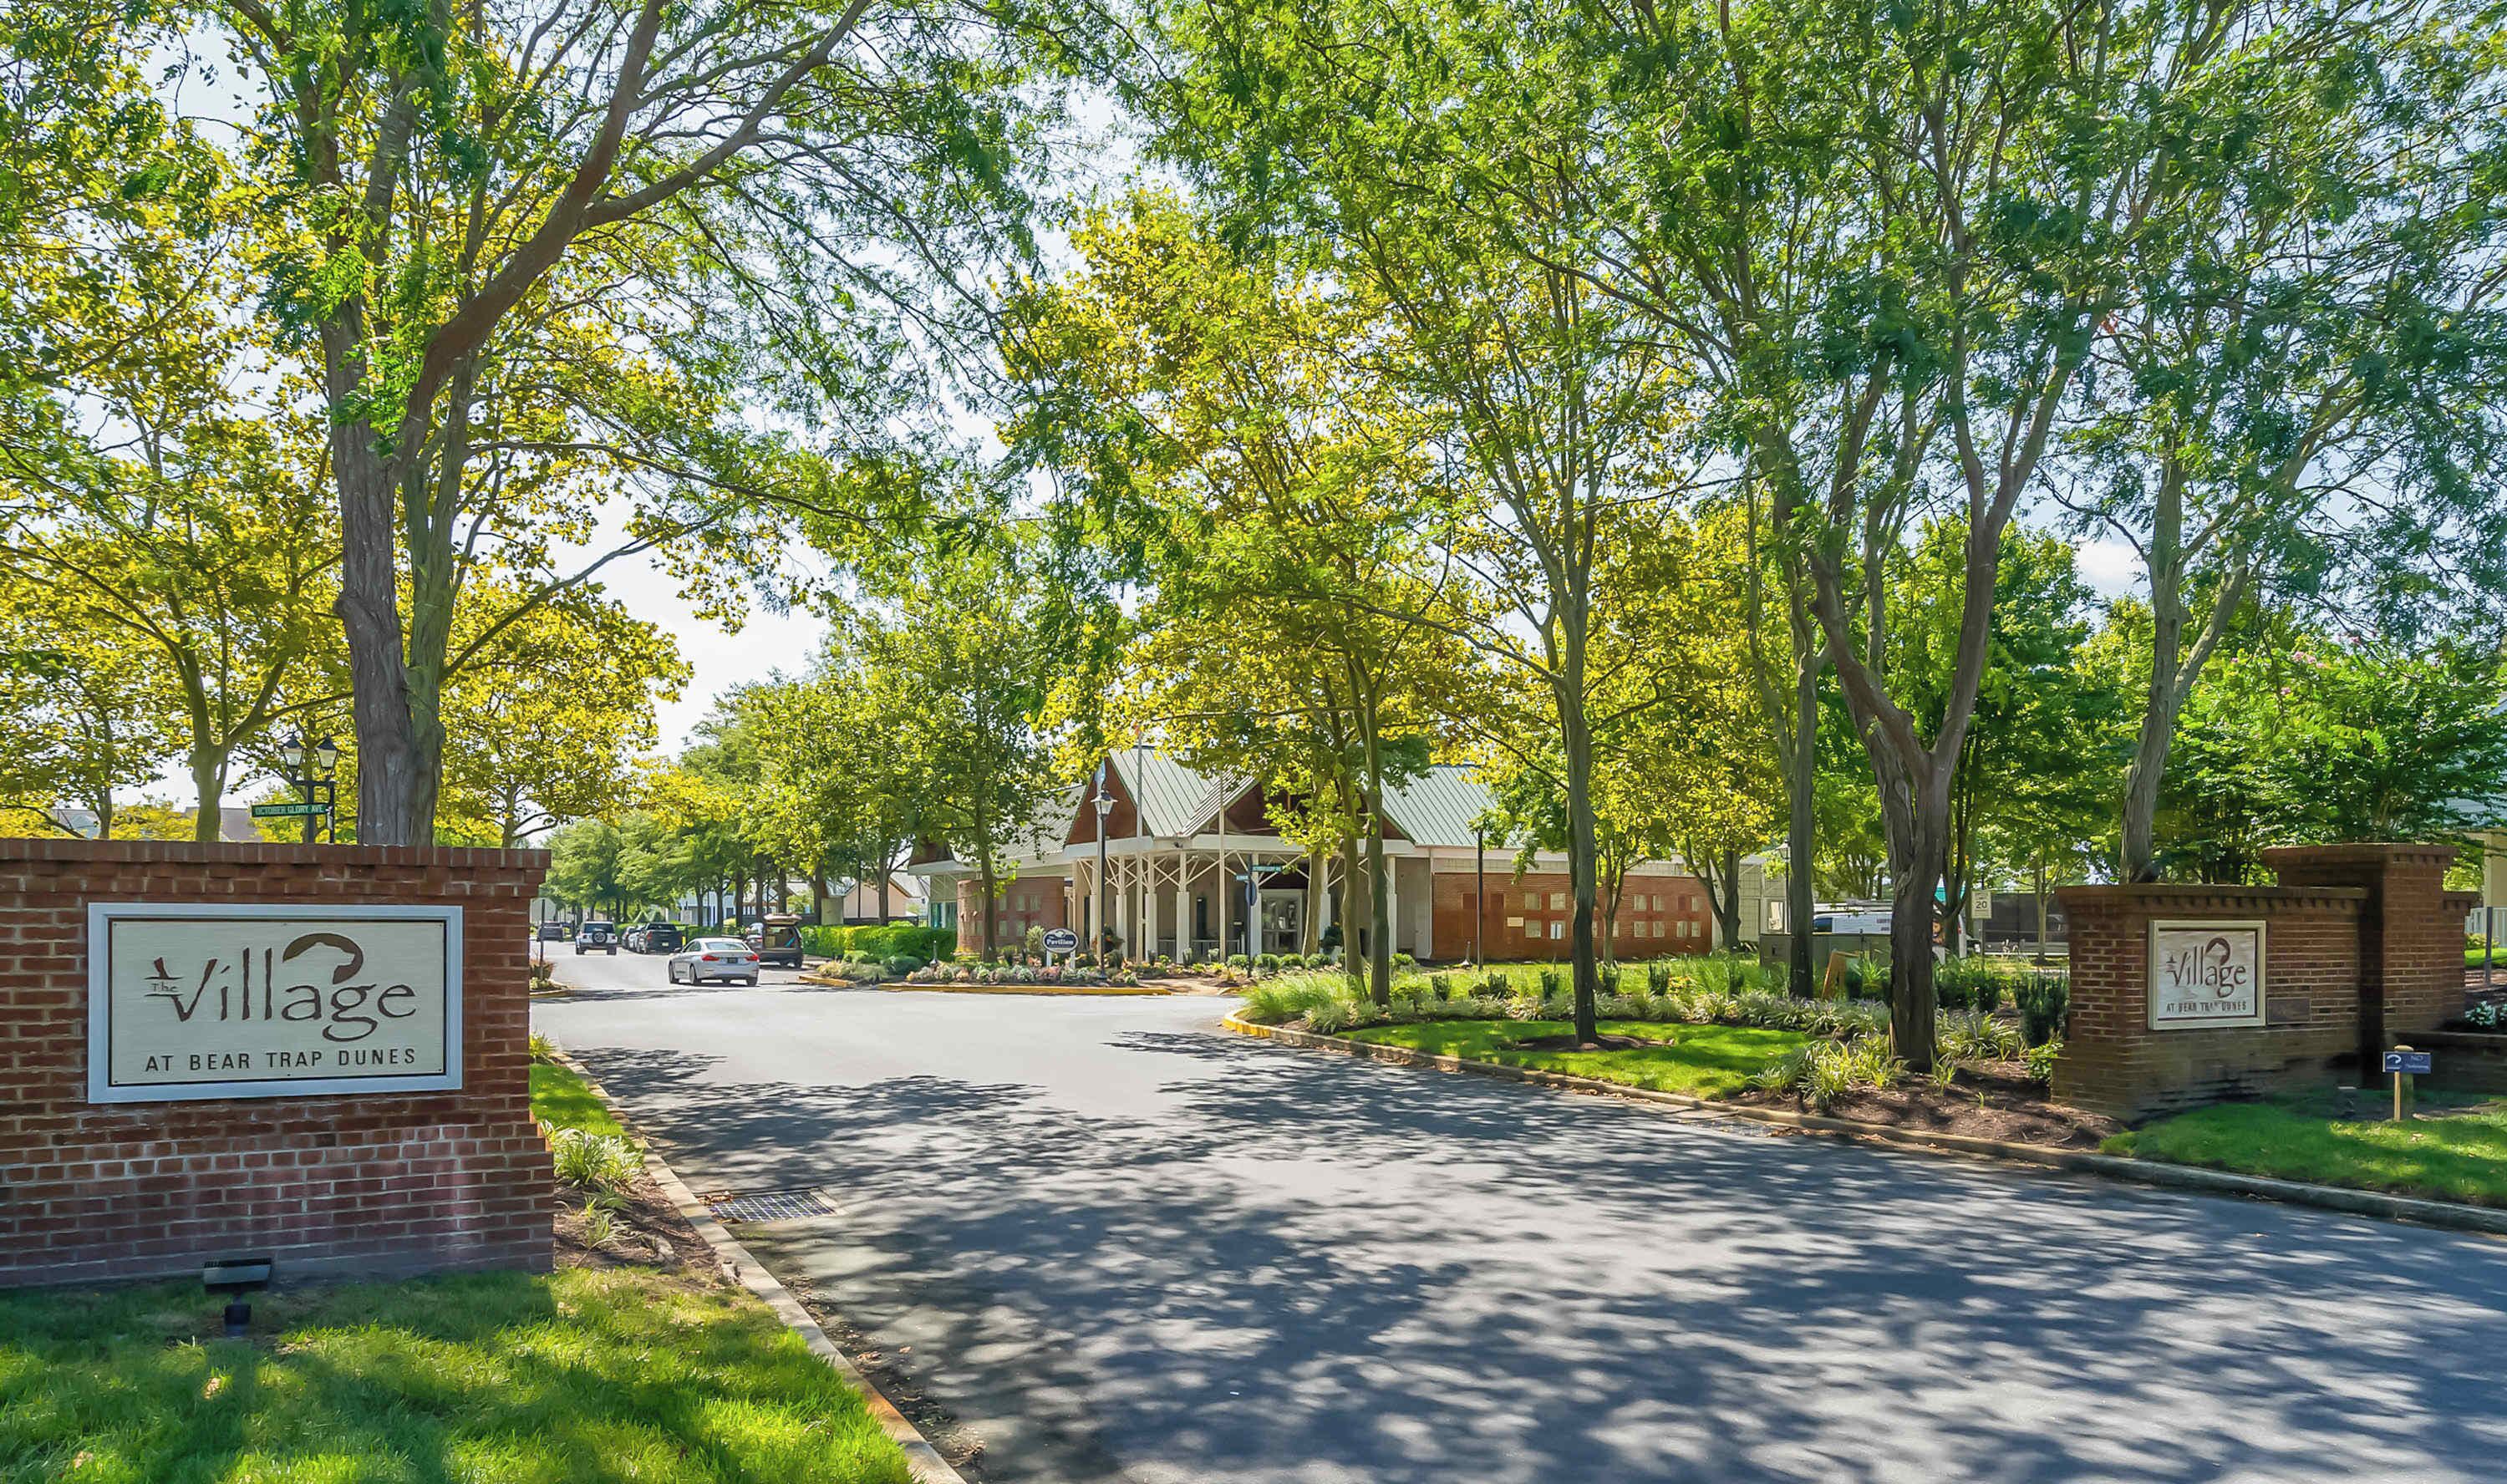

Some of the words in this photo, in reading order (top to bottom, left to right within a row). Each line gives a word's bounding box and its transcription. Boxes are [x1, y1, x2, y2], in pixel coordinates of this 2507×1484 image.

[2170, 946, 2247, 999] Village
[151, 983, 178, 993] The
[154, 947, 416, 1042] Village
[2166, 1004, 2174, 1013] AT
[145, 1055, 174, 1072] AT
[190, 1053, 250, 1071] BEAR
[266, 1051, 323, 1068] TRAP
[338, 1048, 415, 1066] DUNES
